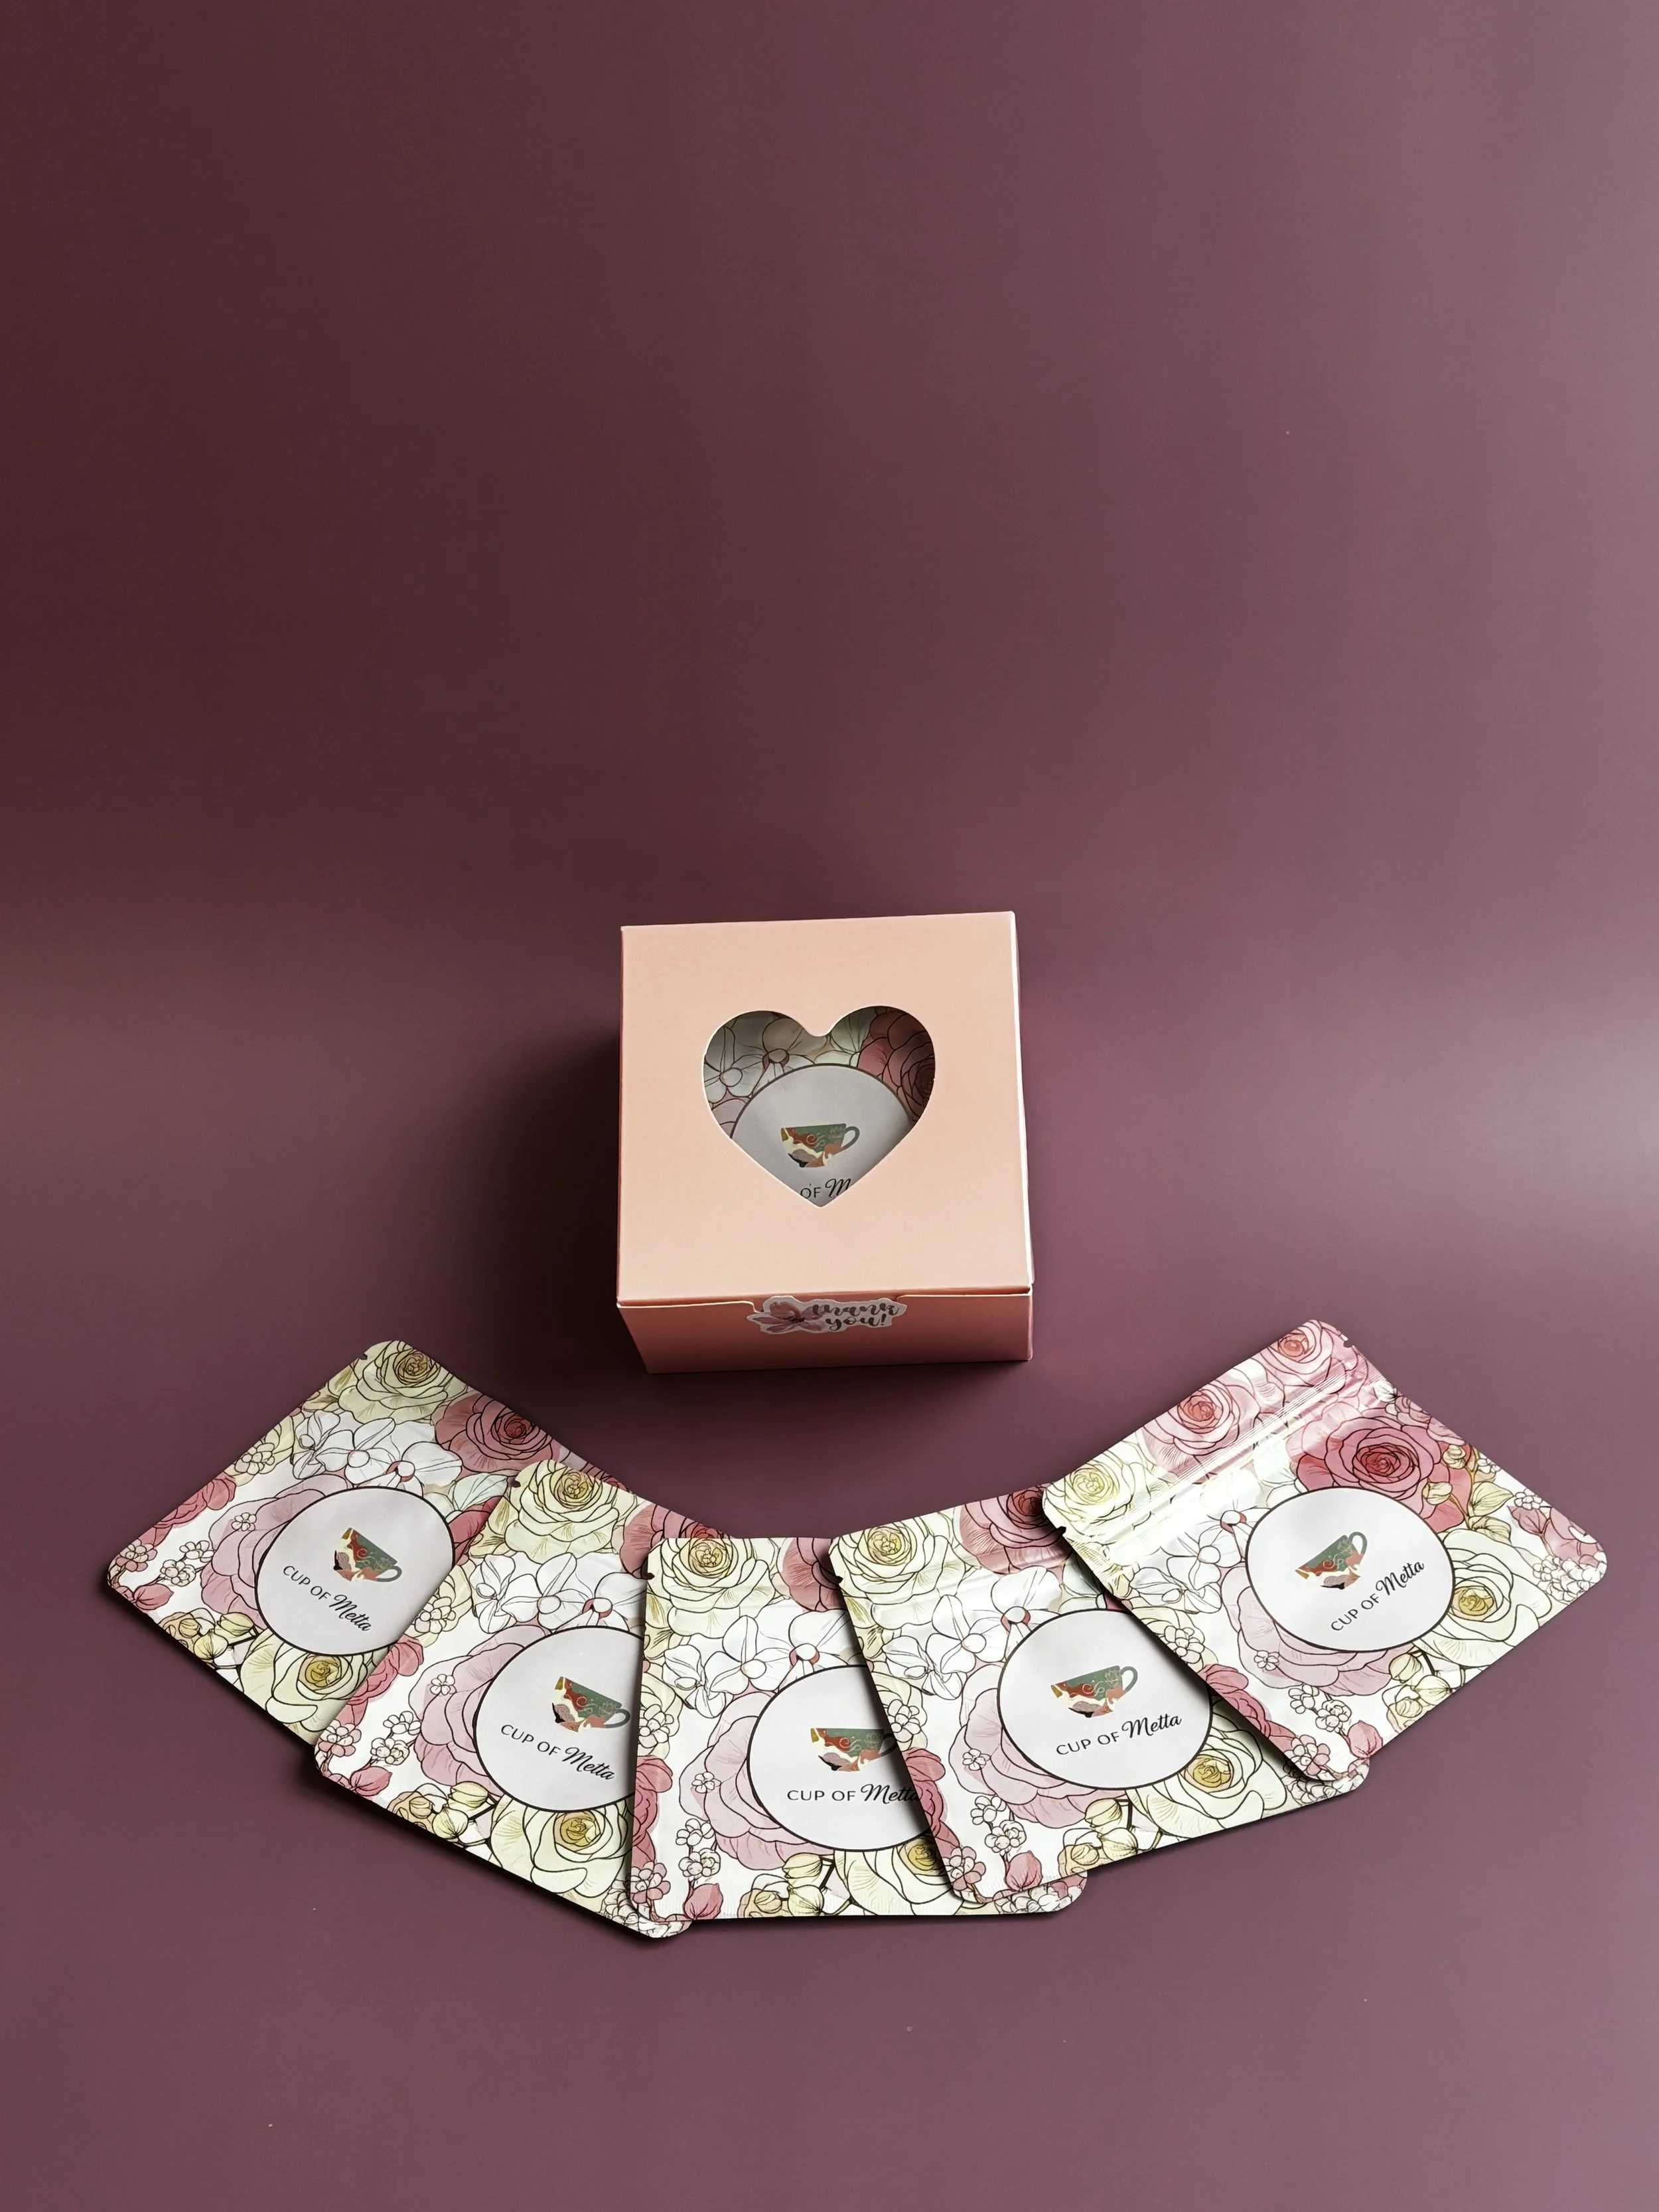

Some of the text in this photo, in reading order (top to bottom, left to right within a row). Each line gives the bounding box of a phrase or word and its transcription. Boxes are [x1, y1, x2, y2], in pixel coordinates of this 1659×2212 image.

[800, 1187, 822, 1199] OF
[825, 1313, 887, 1331] you!
[283, 1565, 372, 1631] CUP OF Metta
[1331, 1561, 1425, 1631] CUP OF Metta
[500, 1724, 615, 1780] CUP OF Metta
[1056, 1714, 1183, 1755] CUP OF Metta
[787, 1790, 825, 1801] CUP
[831, 1790, 856, 1801] OF
